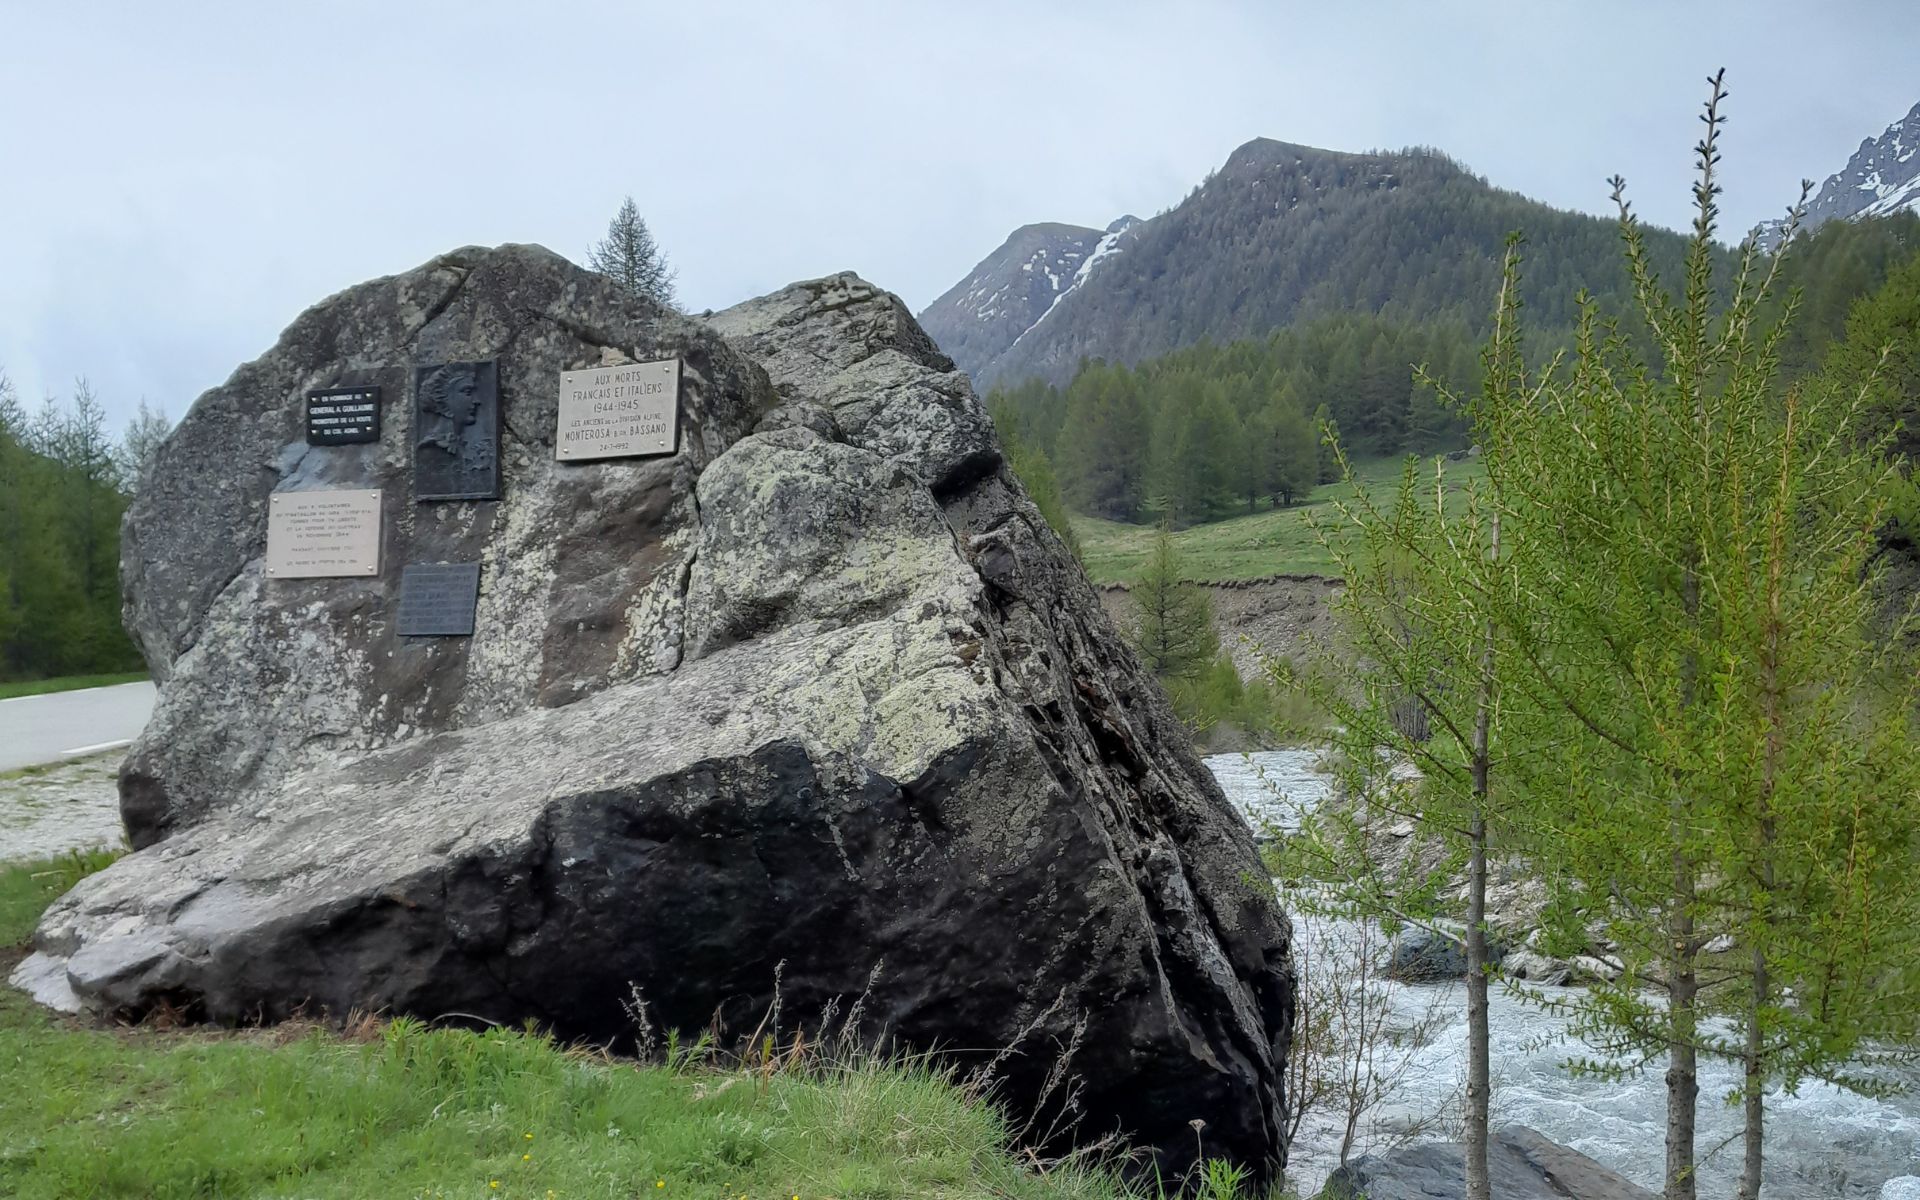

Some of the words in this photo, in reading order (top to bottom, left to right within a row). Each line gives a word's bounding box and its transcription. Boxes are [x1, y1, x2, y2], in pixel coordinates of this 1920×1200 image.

[595, 375, 610, 385] AUX
[615, 371, 640, 383] MORTS
[614, 387, 624, 397] ET
[628, 383, 662, 396] ITALIENS
[342, 404, 374, 412] GUILLAUME
[594, 400, 639, 413] 1944-1945
[564, 428, 610, 441] MONTEROSA
[630, 423, 666, 436] BASSANO
